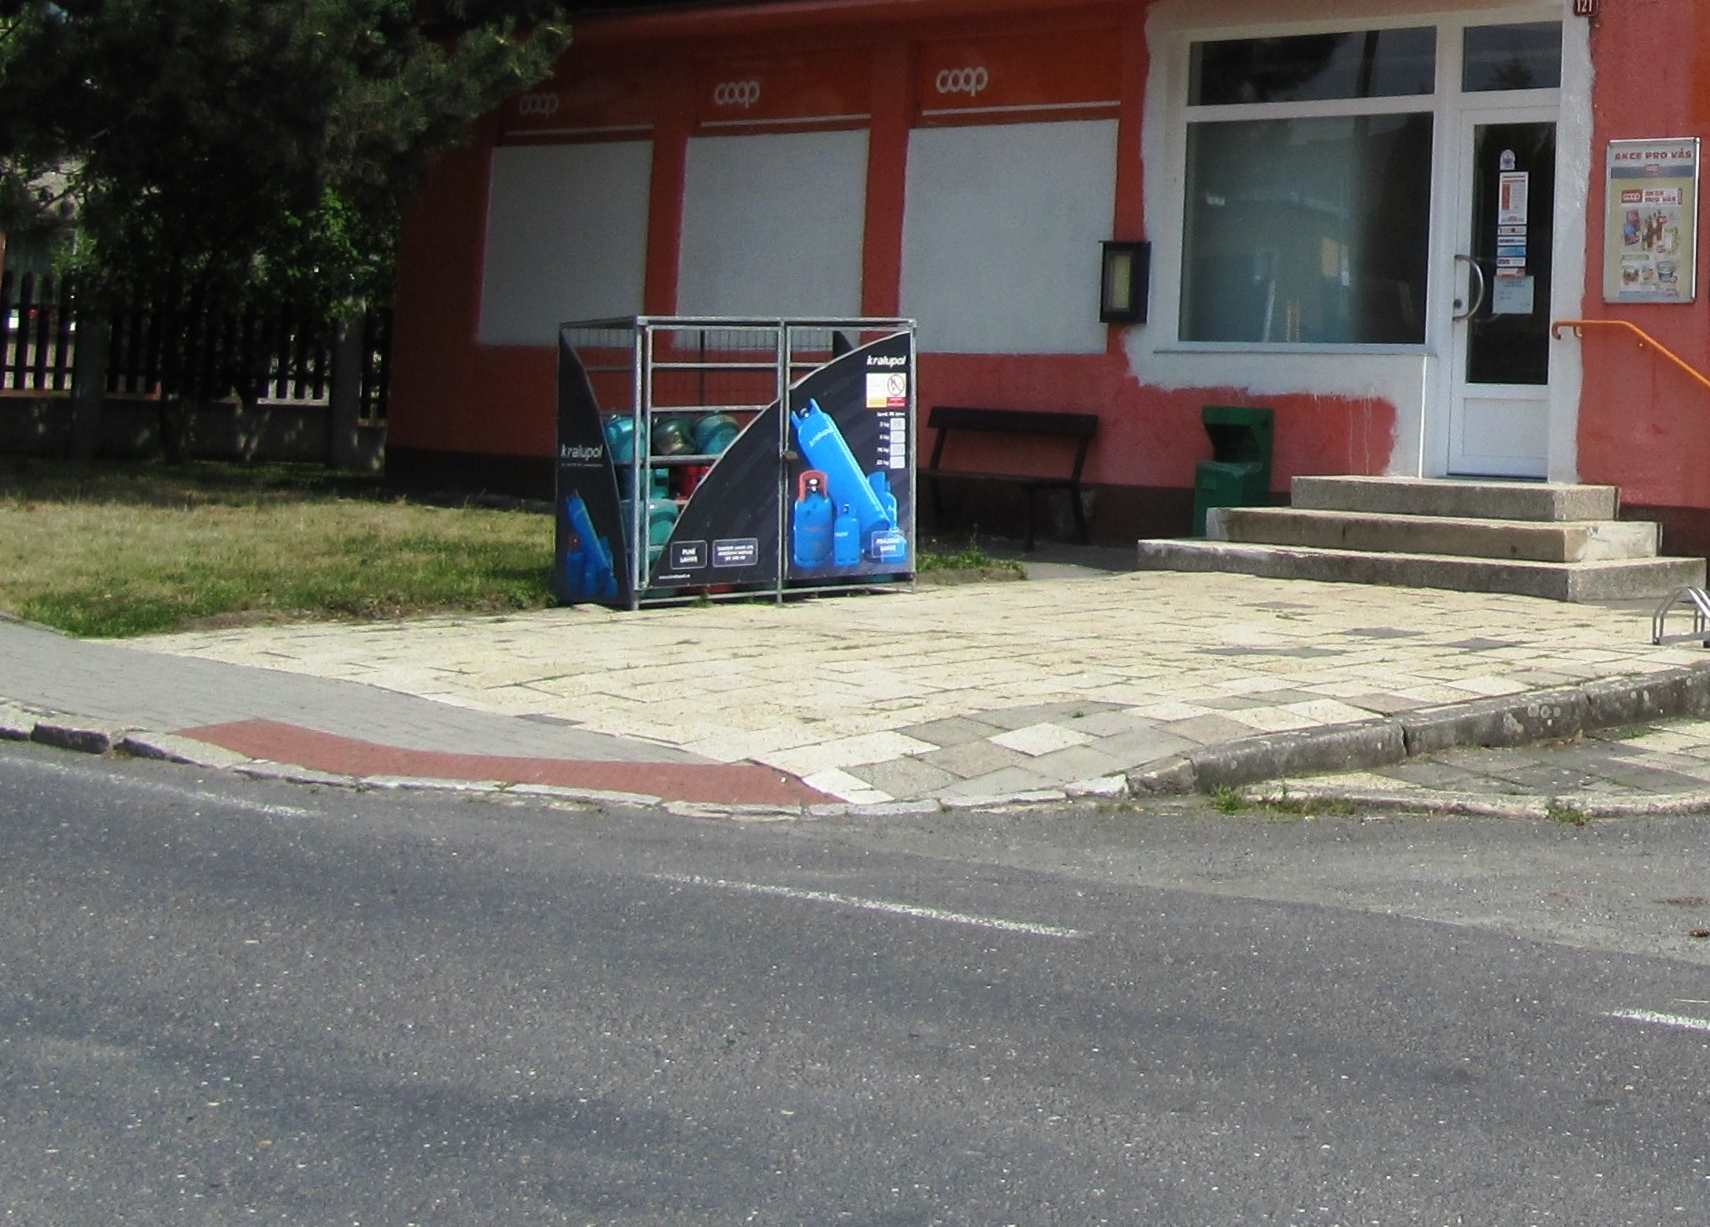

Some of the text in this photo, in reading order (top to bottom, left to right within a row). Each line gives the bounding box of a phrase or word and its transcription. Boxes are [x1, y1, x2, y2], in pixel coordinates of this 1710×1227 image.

[936, 66, 988, 97] coop
[519, 92, 559, 118] coop
[714, 80, 760, 108] coop
[1615, 147, 1692, 161] AKCE PRO VÁS
[866, 355, 906, 368] kralupol
[561, 443, 603, 461] kralupol
